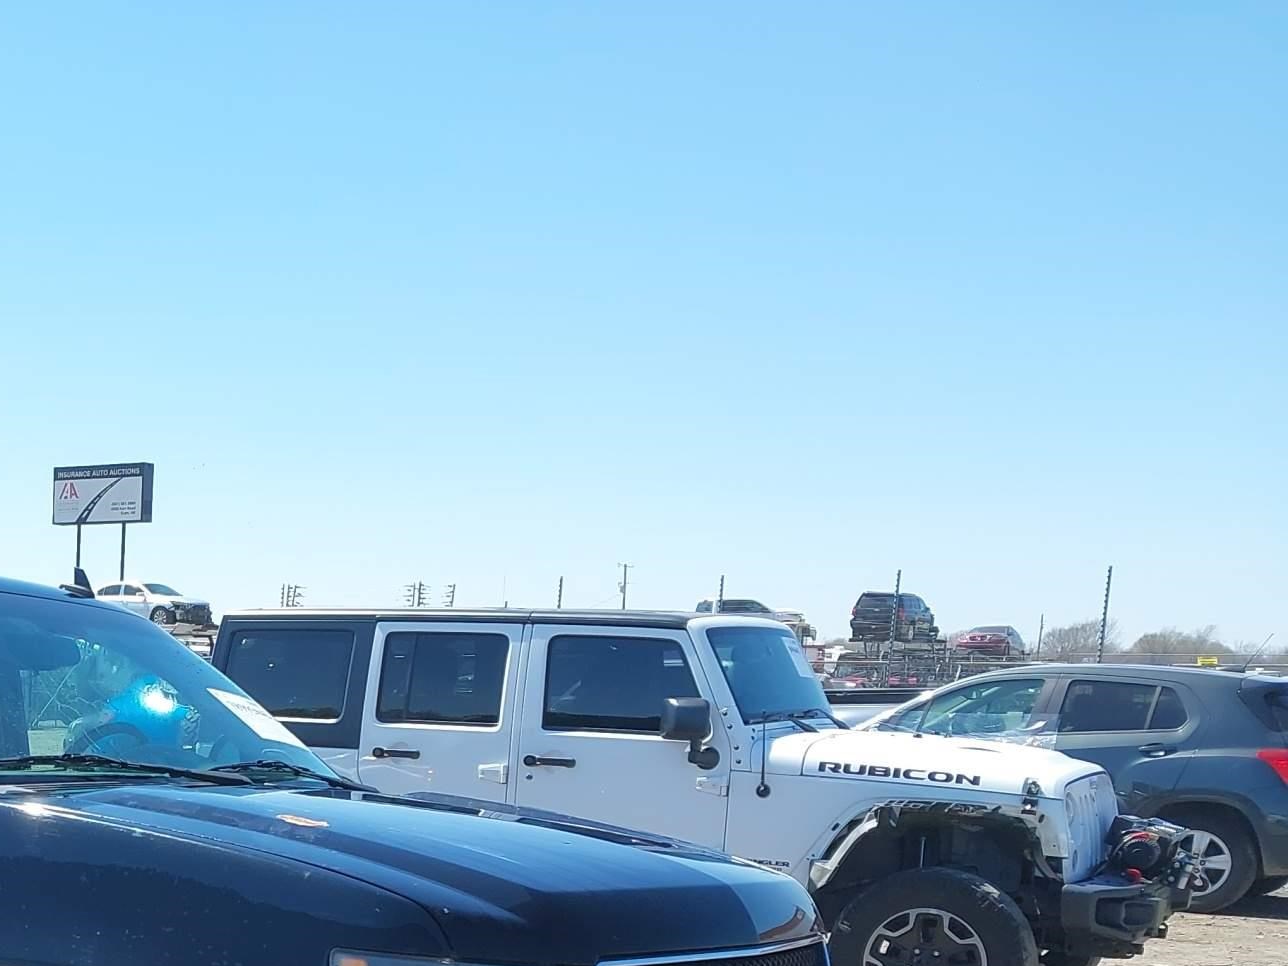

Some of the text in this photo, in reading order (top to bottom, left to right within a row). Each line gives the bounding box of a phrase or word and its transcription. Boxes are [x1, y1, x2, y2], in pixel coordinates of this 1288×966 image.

[57, 467, 140, 479] INSURANCE AUTO AUCTIONS
[818, 761, 981, 786] RUBICON
